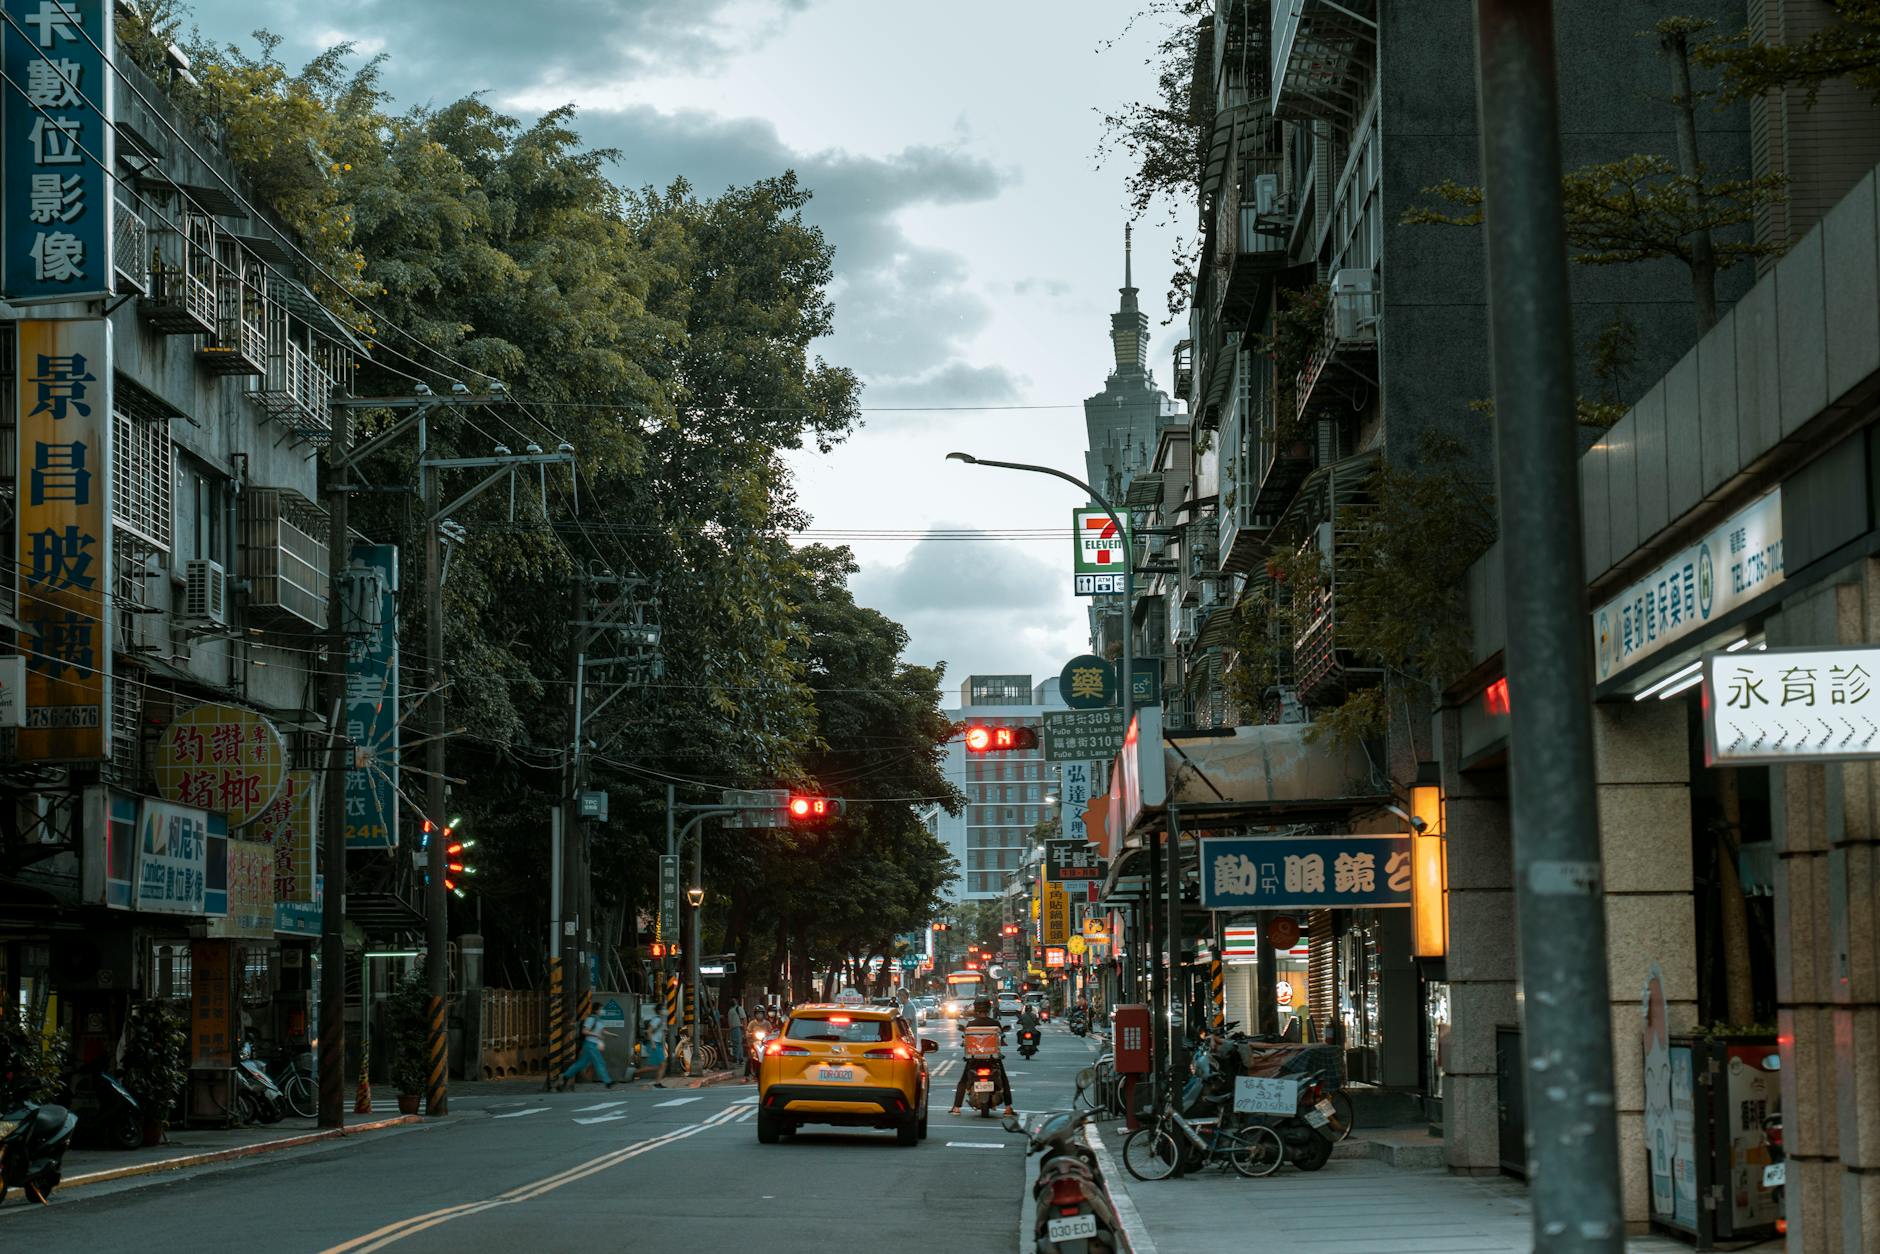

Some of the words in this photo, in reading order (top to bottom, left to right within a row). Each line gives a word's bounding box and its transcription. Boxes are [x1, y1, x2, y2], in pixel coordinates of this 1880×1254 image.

[27, 352, 97, 681] 景昌玻璃
[1071, 667, 1105, 699] 藥
[1725, 663, 1872, 709] 永育診
[1051, 1222, 1095, 1239] 030-ECU
